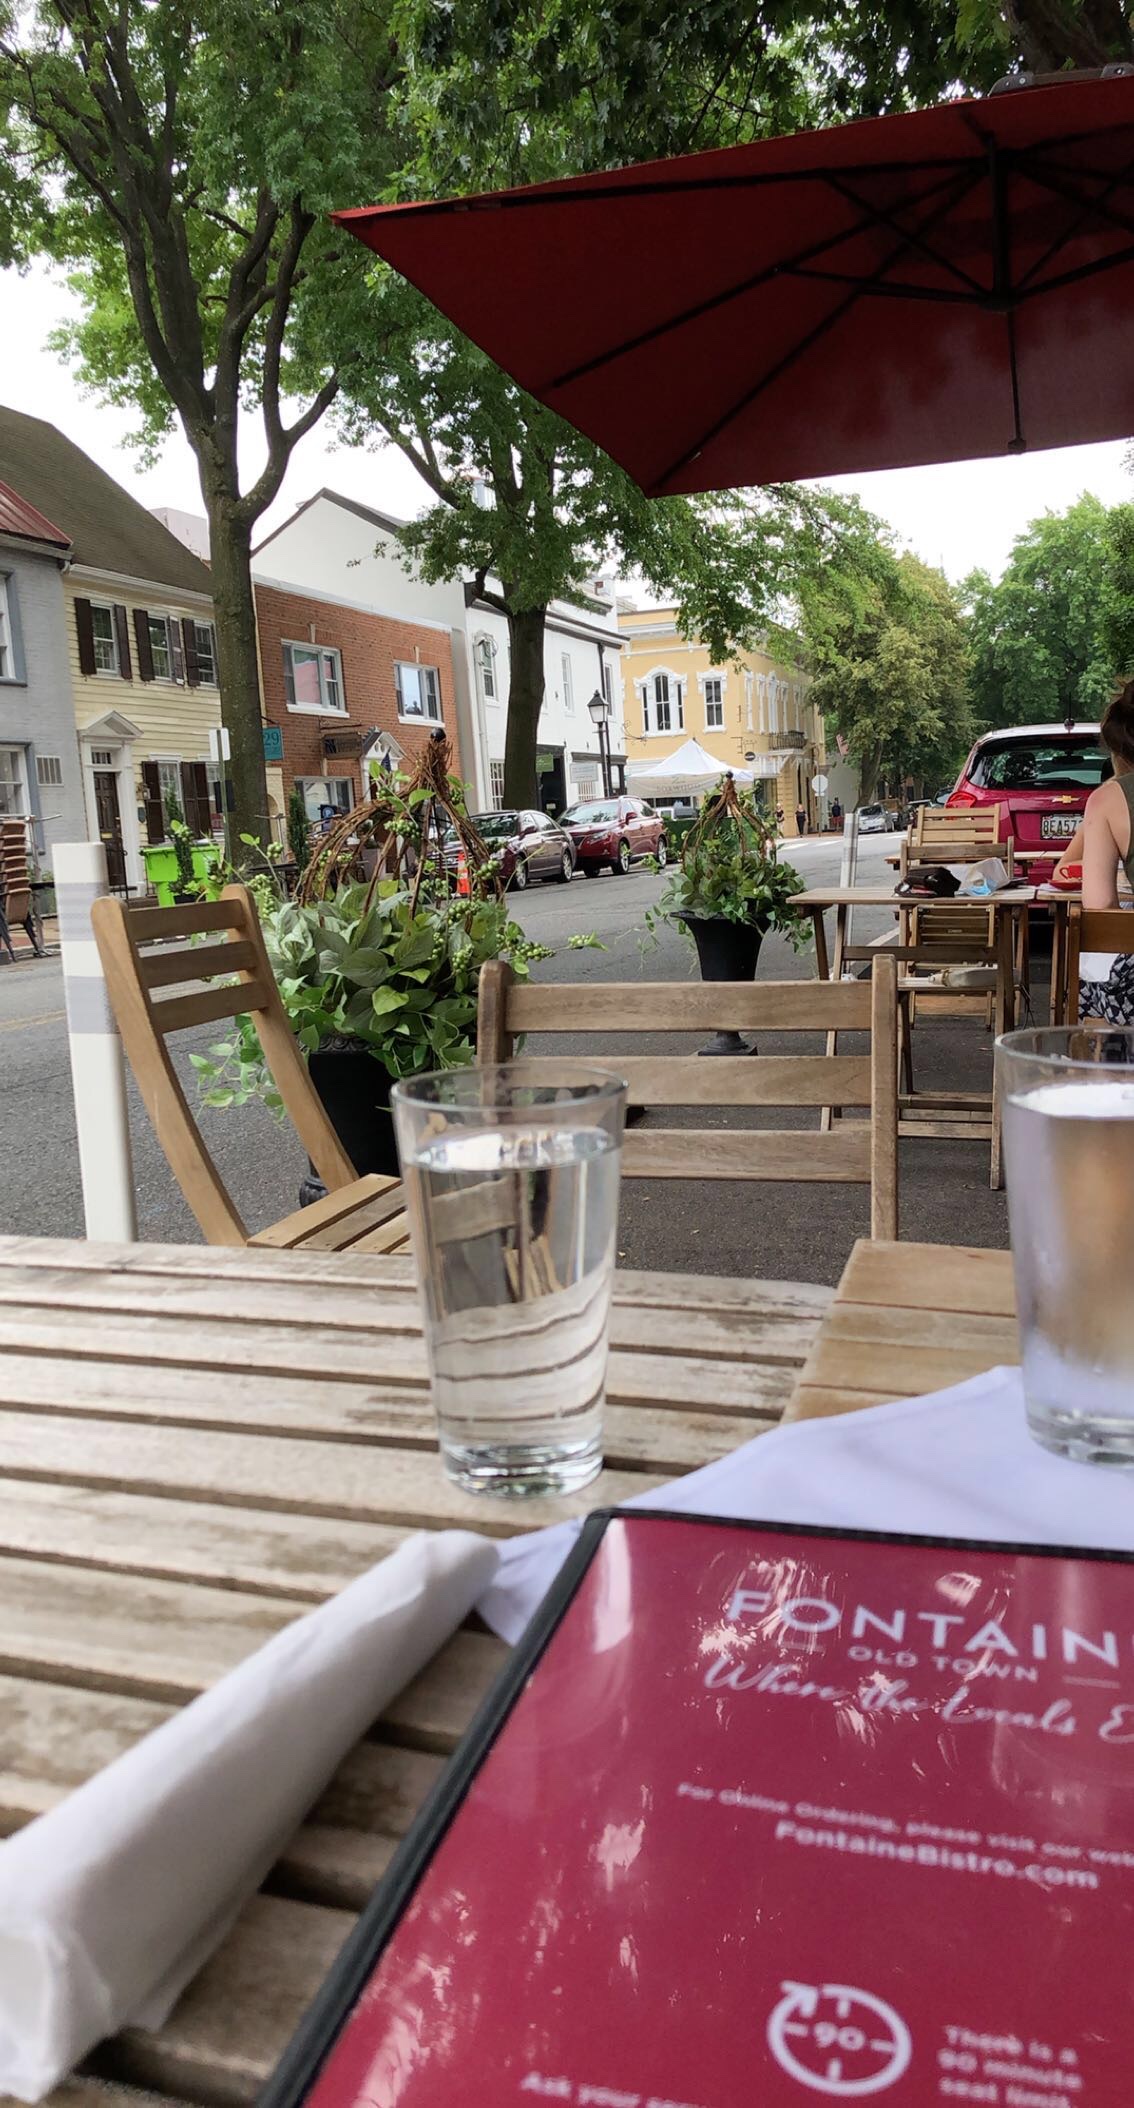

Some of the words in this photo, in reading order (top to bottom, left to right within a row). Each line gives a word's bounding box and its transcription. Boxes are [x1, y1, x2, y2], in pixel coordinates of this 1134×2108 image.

[1043, 819, 1084, 834] 8EA57
[725, 1588, 1134, 1668] FONTAIN
[847, 1645, 918, 1668] OLD
[931, 1656, 1038, 1682] TOWN
[704, 1655, 850, 1700] Where
[860, 1676, 931, 1714] the
[941, 1684, 1076, 1736] Locals
[677, 1781, 714, 1801] For
[718, 1788, 790, 1814] Online
[905, 1822, 982, 1845] please
[986, 1833, 1036, 1852] visit
[774, 1820, 1099, 1889] FontaineBistro.com
[814, 2021, 866, 2051] 90
[945, 2025, 1024, 2056] There
[1029, 2038, 1053, 2062] is
[1059, 2048, 1078, 2066] a
[520, 2071, 572, 2098] Ask
[937, 2049, 978, 2073] 90
[982, 2059, 1083, 2092] minute
